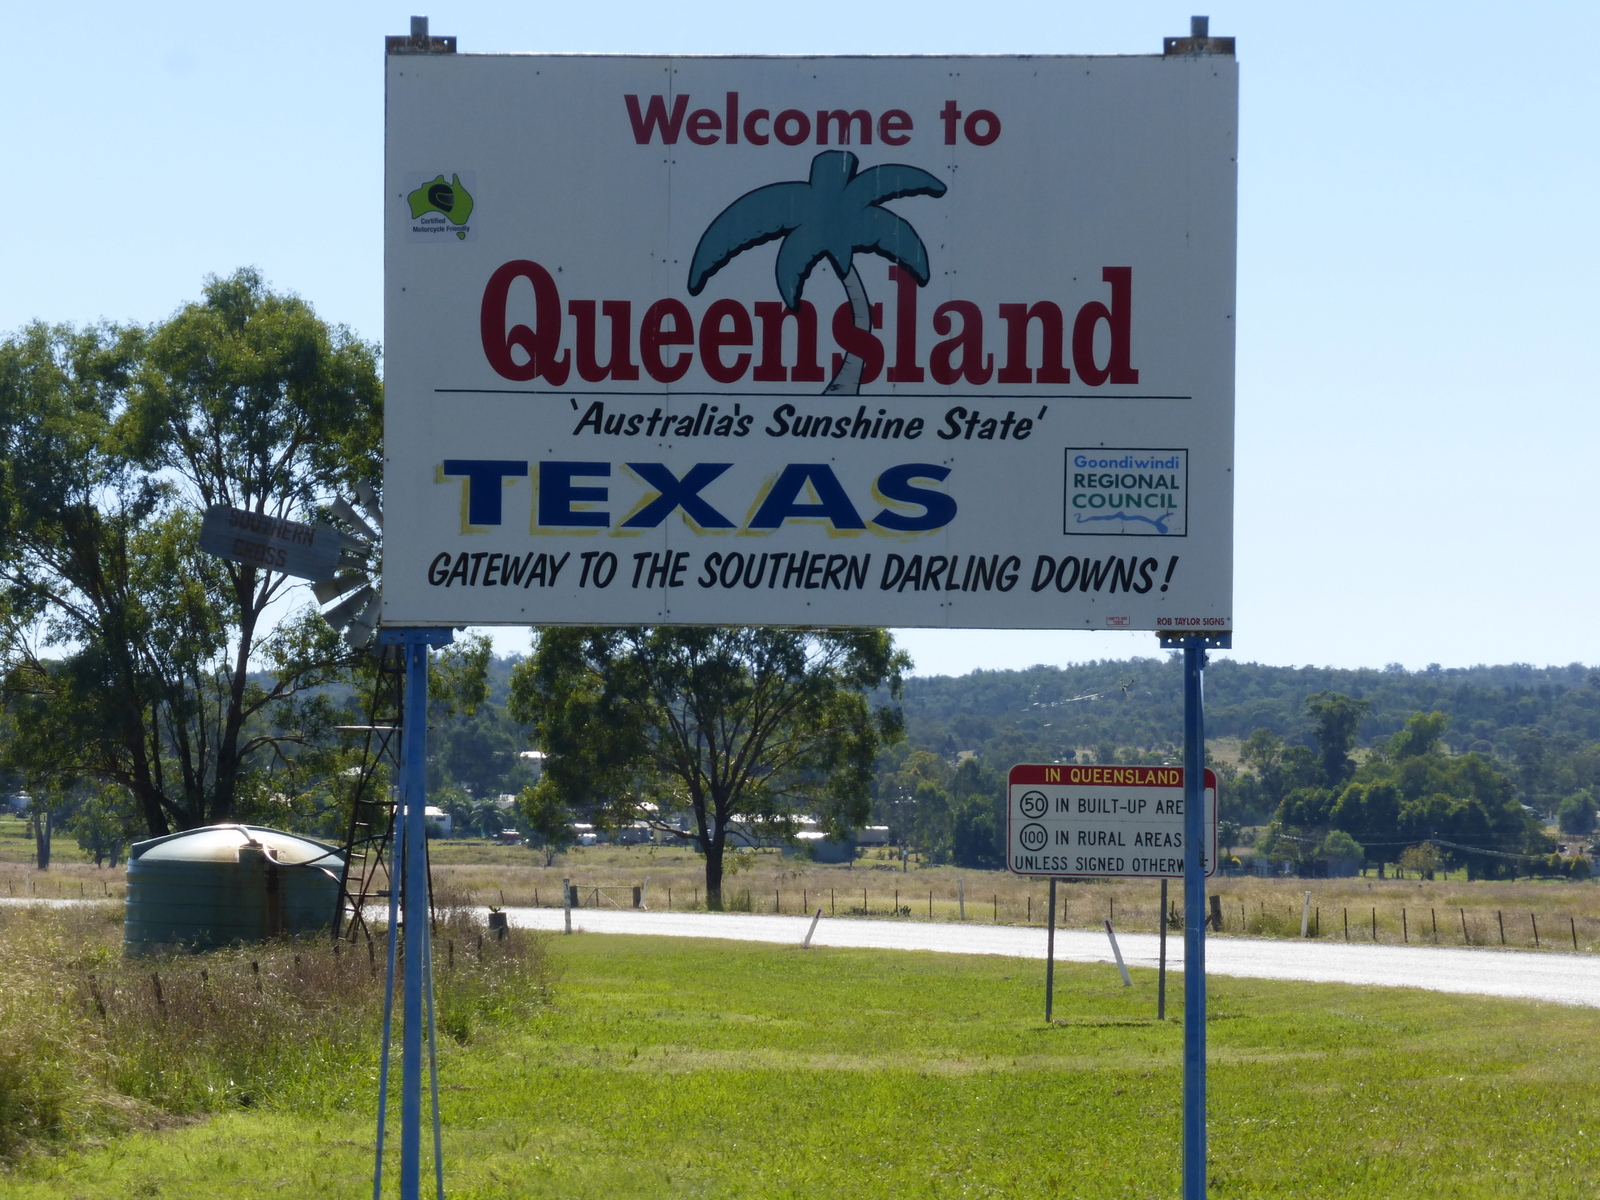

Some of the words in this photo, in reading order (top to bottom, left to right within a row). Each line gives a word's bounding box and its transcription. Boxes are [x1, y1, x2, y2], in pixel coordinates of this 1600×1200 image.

[623, 91, 914, 146] Welcome
[939, 99, 1002, 146] to
[480, 259, 1139, 386] Queensland
[765, 403, 924, 440] Sunshine
[1074, 455, 1180, 469] Goondiwindi
[1073, 473, 1180, 489] REGIONAL
[435, 459, 958, 540] TEXAS
[1072, 493, 1178, 508] COUNCIL
[428, 551, 571, 588] GATEWAY
[578, 551, 618, 588] TO
[631, 550, 691, 588] THE
[697, 549, 871, 589] SOUTHERN
[880, 553, 1021, 592] DARLING
[1030, 555, 1179, 594] DOWNS!
[1157, 617, 1172, 625] ROB
[1175, 617, 1200, 625] TAYLOR
[1203, 617, 1225, 626] SIGNS
[1045, 767, 1061, 782] IN
[1070, 769, 1180, 785] QUEENSLAND
[1024, 798, 1045, 812] 50
[1055, 798, 1069, 812] IN
[1078, 799, 1147, 814] BUILT-UP
[1155, 800, 1184, 815] ARE
[1023, 831, 1044, 844] 100
[1055, 830, 1069, 845] IN
[1078, 831, 1126, 846] RURAL
[1134, 832, 1182, 848] AREAS
[1015, 856, 1068, 870] UNLESS
[1075, 857, 1124, 871] SIGNED
